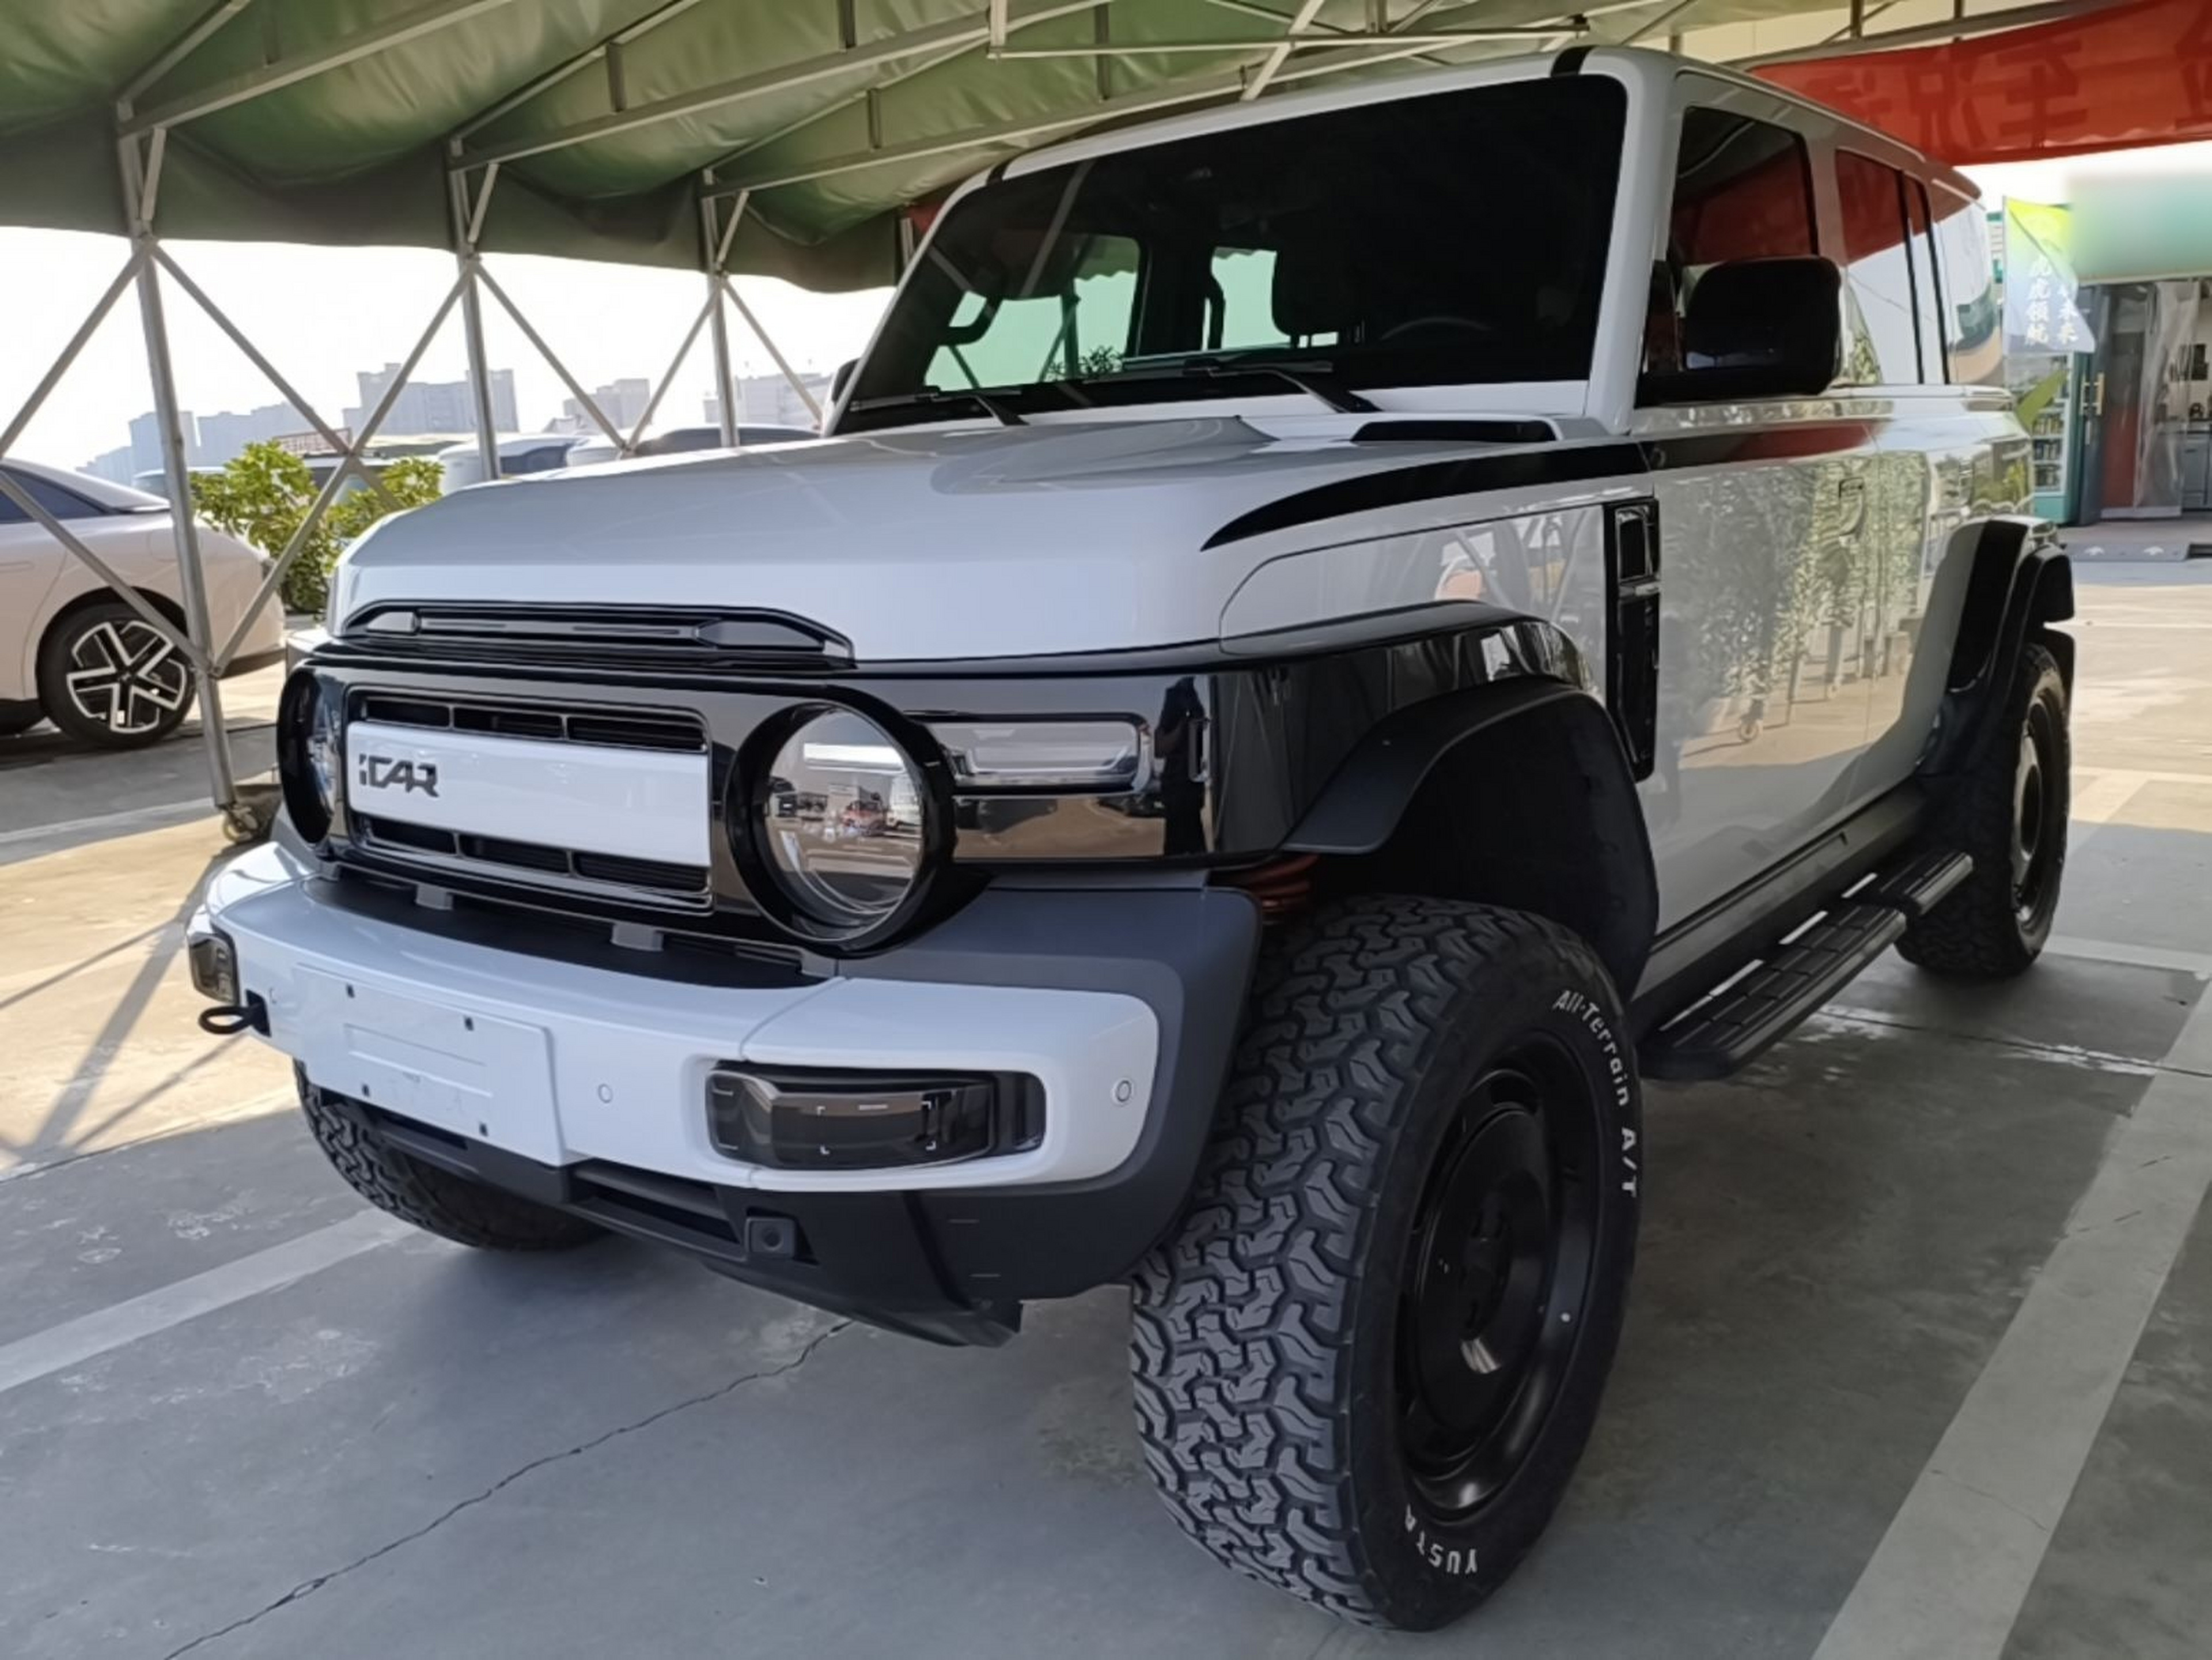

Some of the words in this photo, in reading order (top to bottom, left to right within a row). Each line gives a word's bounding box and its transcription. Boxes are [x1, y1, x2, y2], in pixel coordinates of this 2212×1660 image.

[1552, 989, 1630, 1107] All-Terrain
[1621, 1126, 1638, 1198] A/T
[1404, 1501, 1478, 1575] YUSTA
